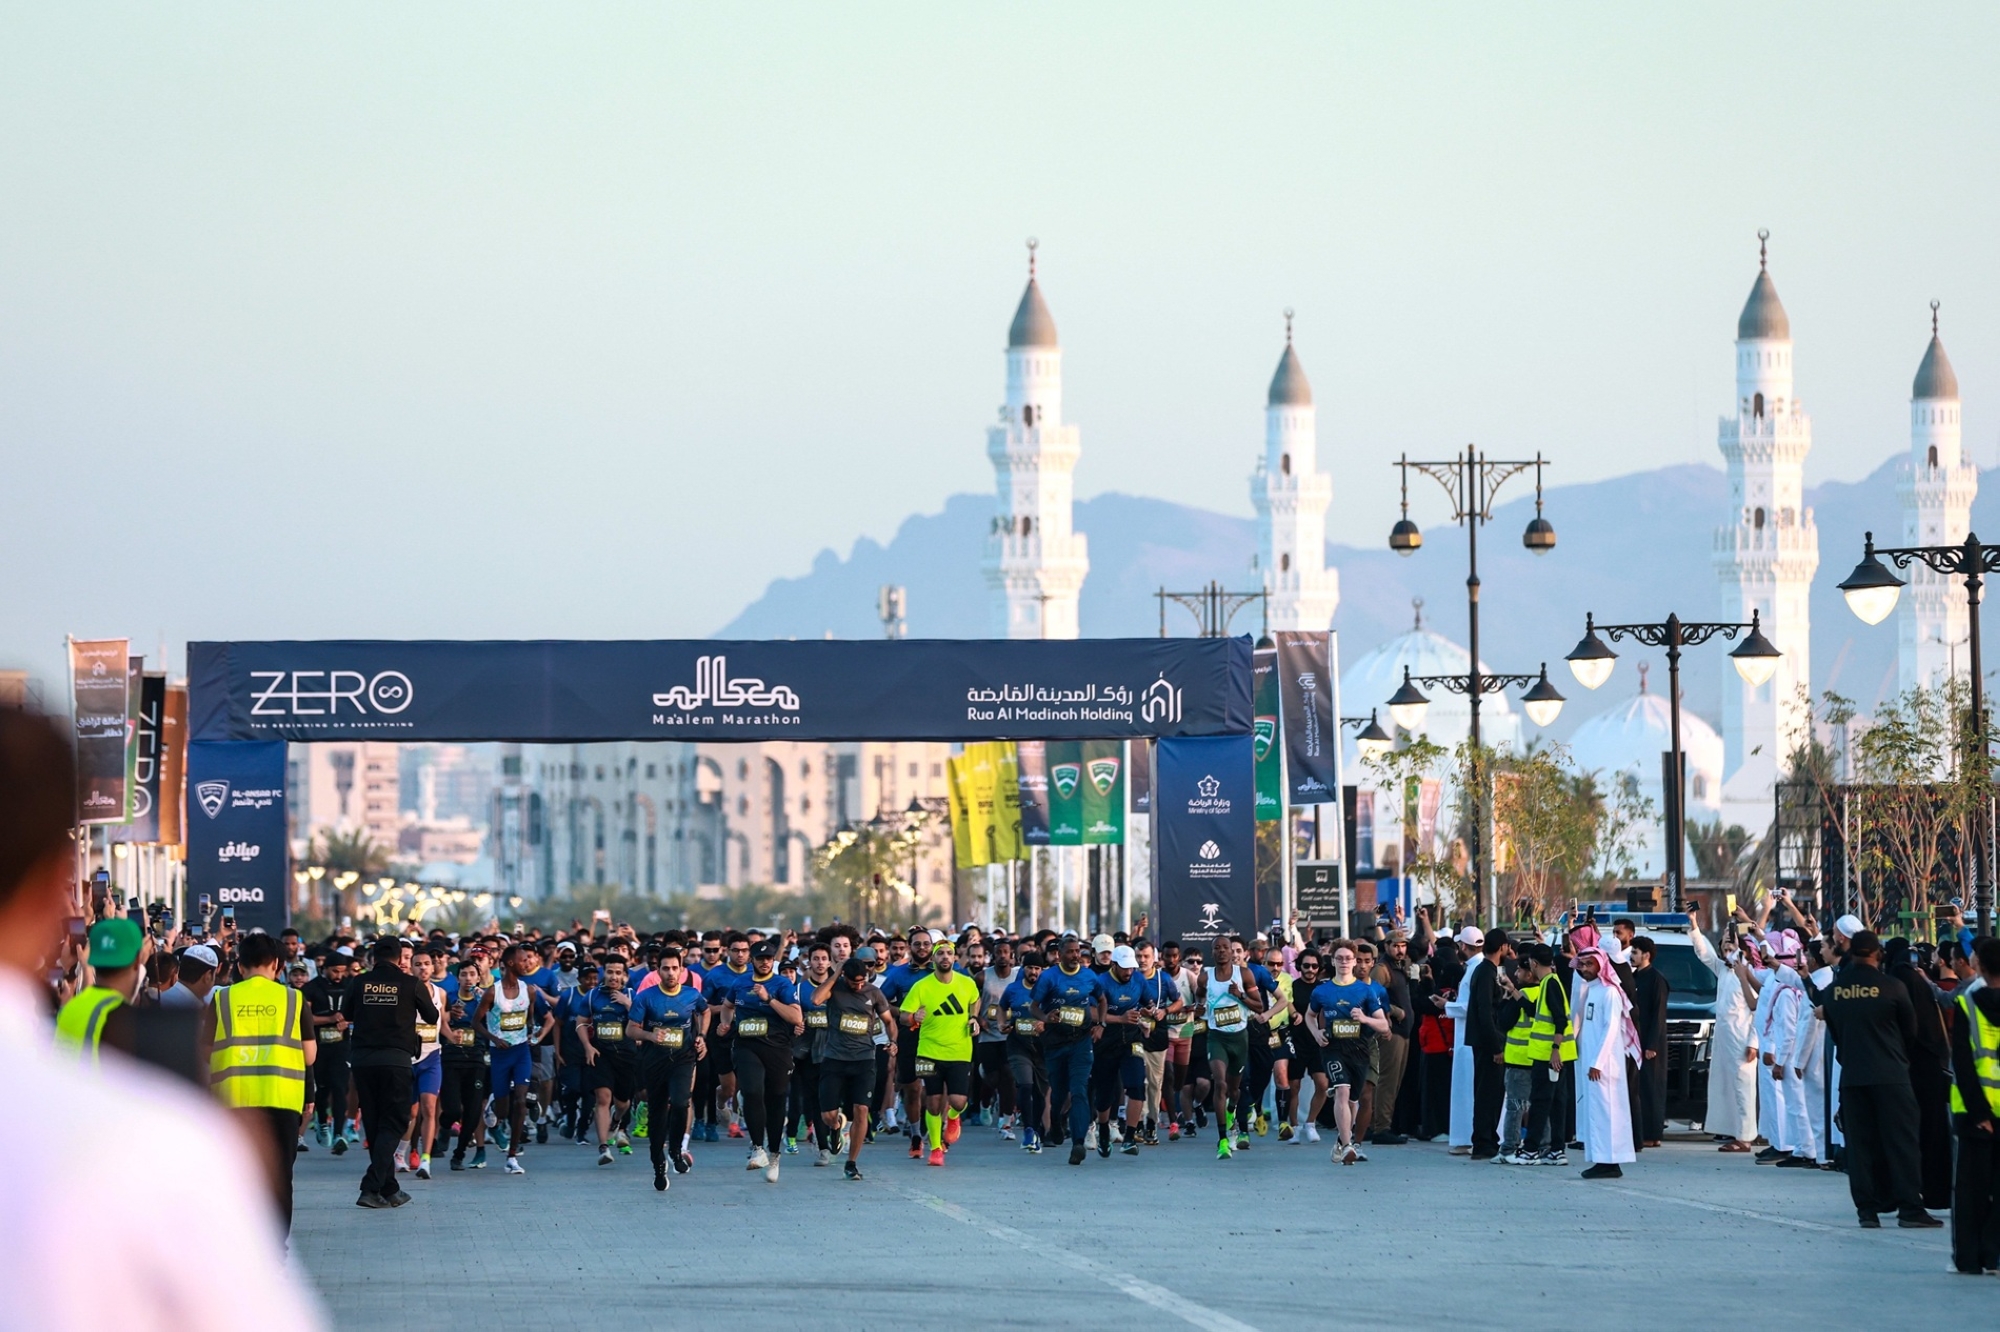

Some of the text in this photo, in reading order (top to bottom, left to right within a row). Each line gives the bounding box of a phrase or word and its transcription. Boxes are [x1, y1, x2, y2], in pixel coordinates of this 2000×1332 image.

[250, 670, 414, 715] ZERO
[967, 683, 1034, 704] القابضة
[1036, 683, 1096, 705] المدينة
[652, 713, 800, 725] Ma'alem Marathon
[967, 707, 1134, 725] Rua Al Madinah Holding
[272, 789, 283, 798] FC
[1213, 798, 1231, 807] وزارة
[1215, 807, 1231, 815] Sport
[364, 983, 398, 994] Police
[1834, 984, 1880, 1001] Police
[237, 1005, 277, 1017] ZERO
[1214, 1008, 1240, 1022] 10130
[597, 1027, 621, 1035] 10071
[739, 1023, 766, 1032] 10011
[1334, 1025, 1360, 1033] 10007
[664, 1033, 682, 1042] 264
[239, 1045, 271, 1063] 577
